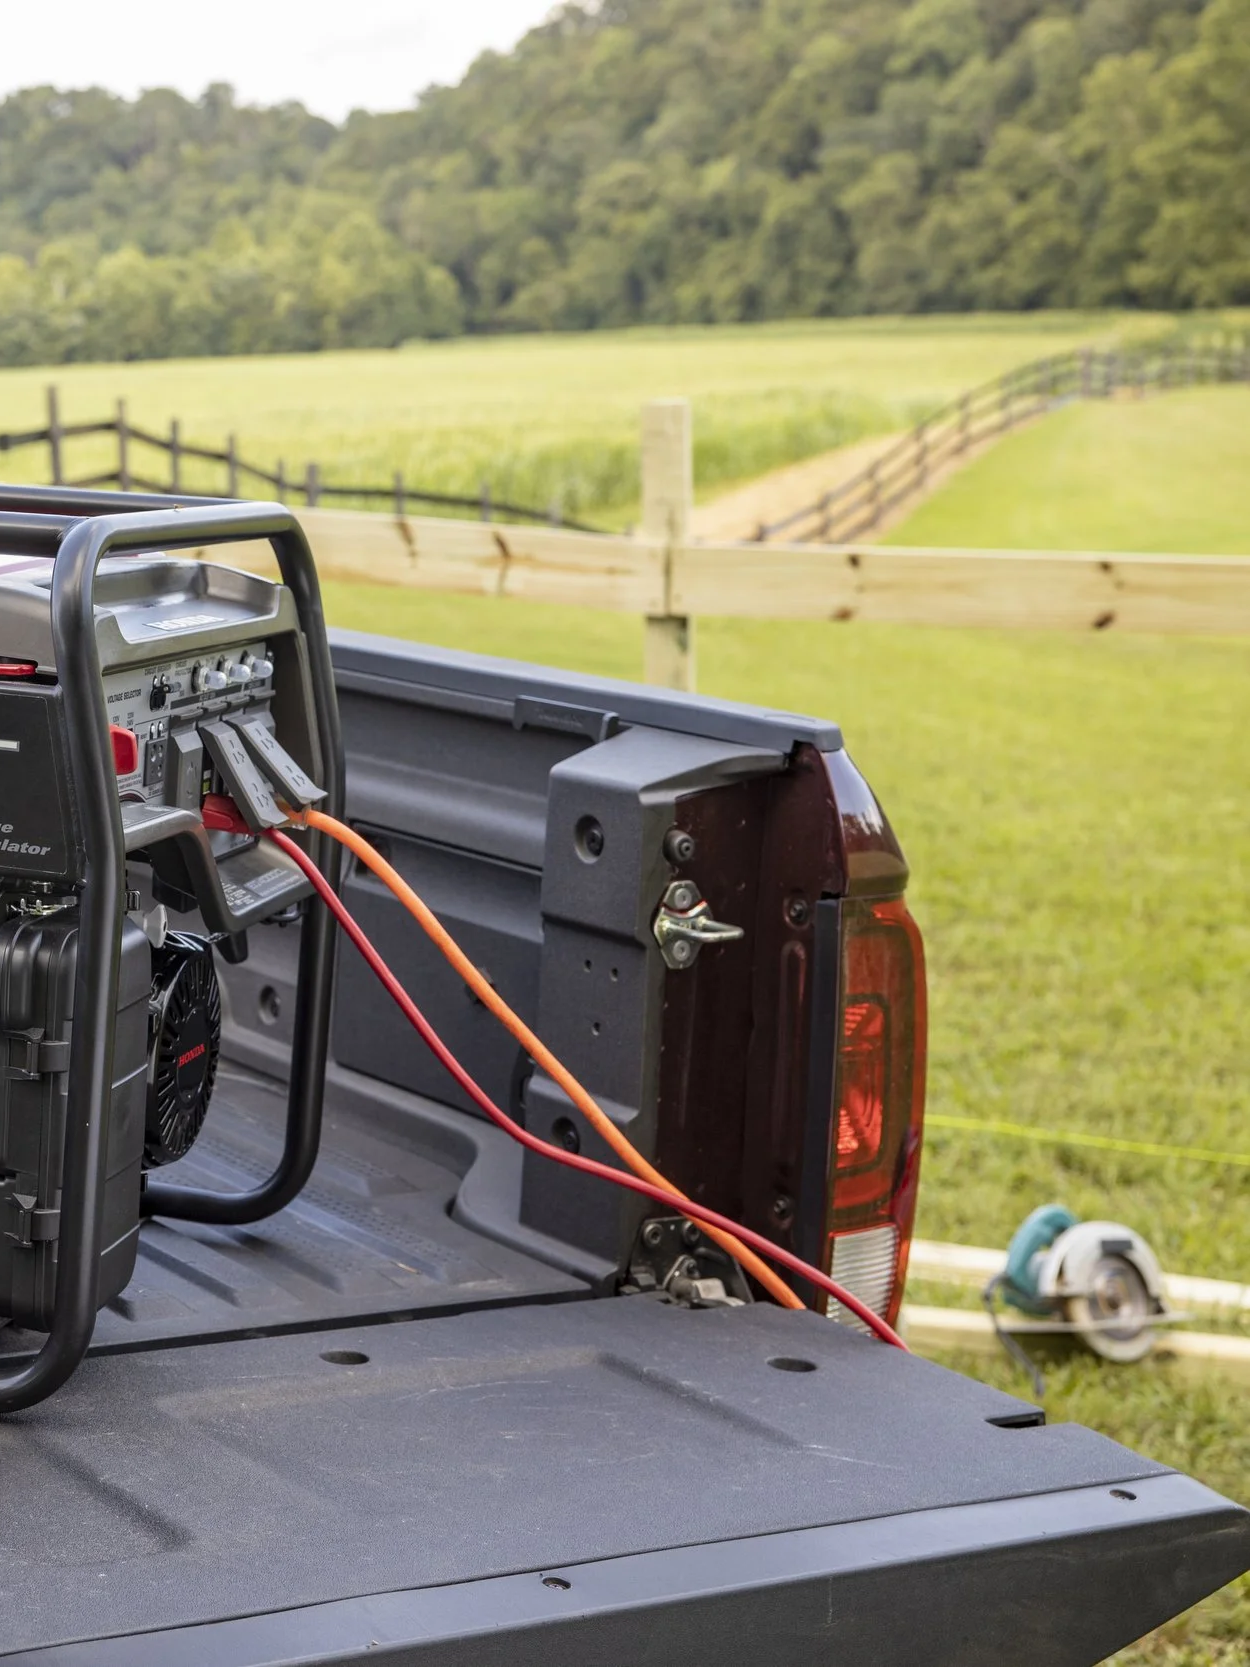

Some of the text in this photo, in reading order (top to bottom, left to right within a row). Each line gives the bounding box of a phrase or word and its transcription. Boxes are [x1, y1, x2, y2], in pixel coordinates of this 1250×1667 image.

[107, 689, 141, 704] VOLTAGE SELECTOR
[178, 1044, 205, 1067] HONDA
